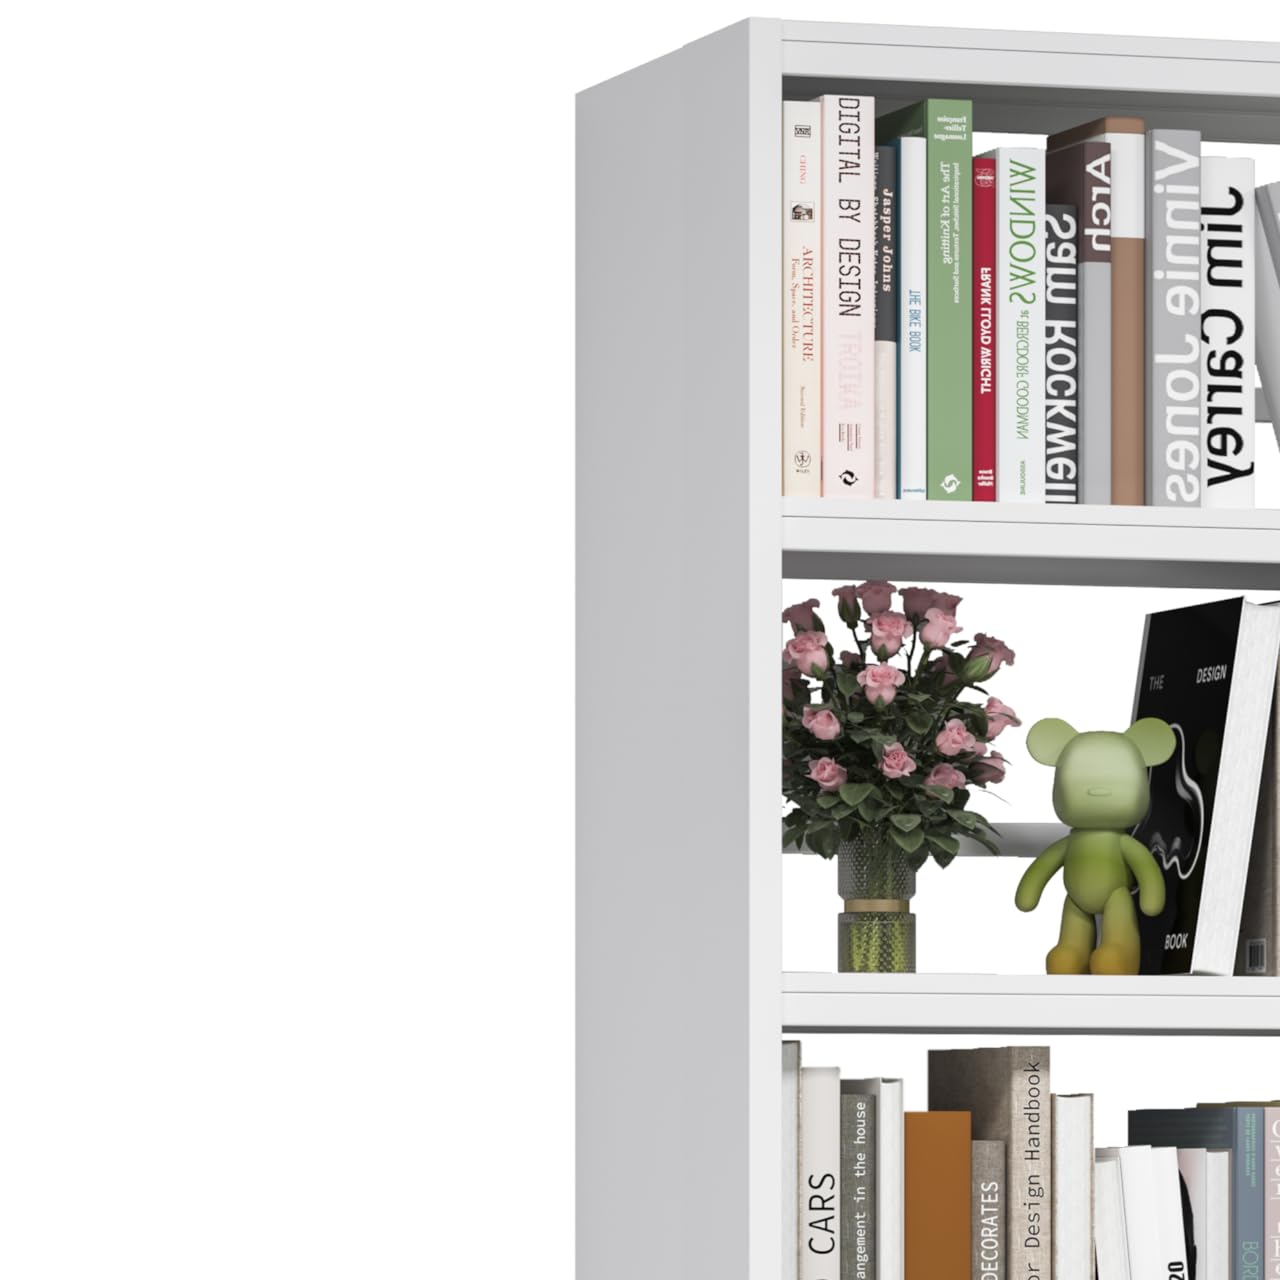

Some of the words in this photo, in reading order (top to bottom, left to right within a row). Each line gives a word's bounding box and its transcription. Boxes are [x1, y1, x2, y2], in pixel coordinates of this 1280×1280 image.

[839, 98, 860, 183] DIGITAL
[839, 199, 860, 223] BY
[880, 189, 893, 241] Jasper
[839, 239, 861, 316] DESIGN
[883, 246, 893, 291] Johns
[802, 247, 813, 361] ARCHITECTURE
[1150, 675, 1164, 690] THE
[1196, 665, 1227, 683] DESIGN
[1165, 933, 1188, 949] BOOK
[808, 1174, 835, 1254] CARS
